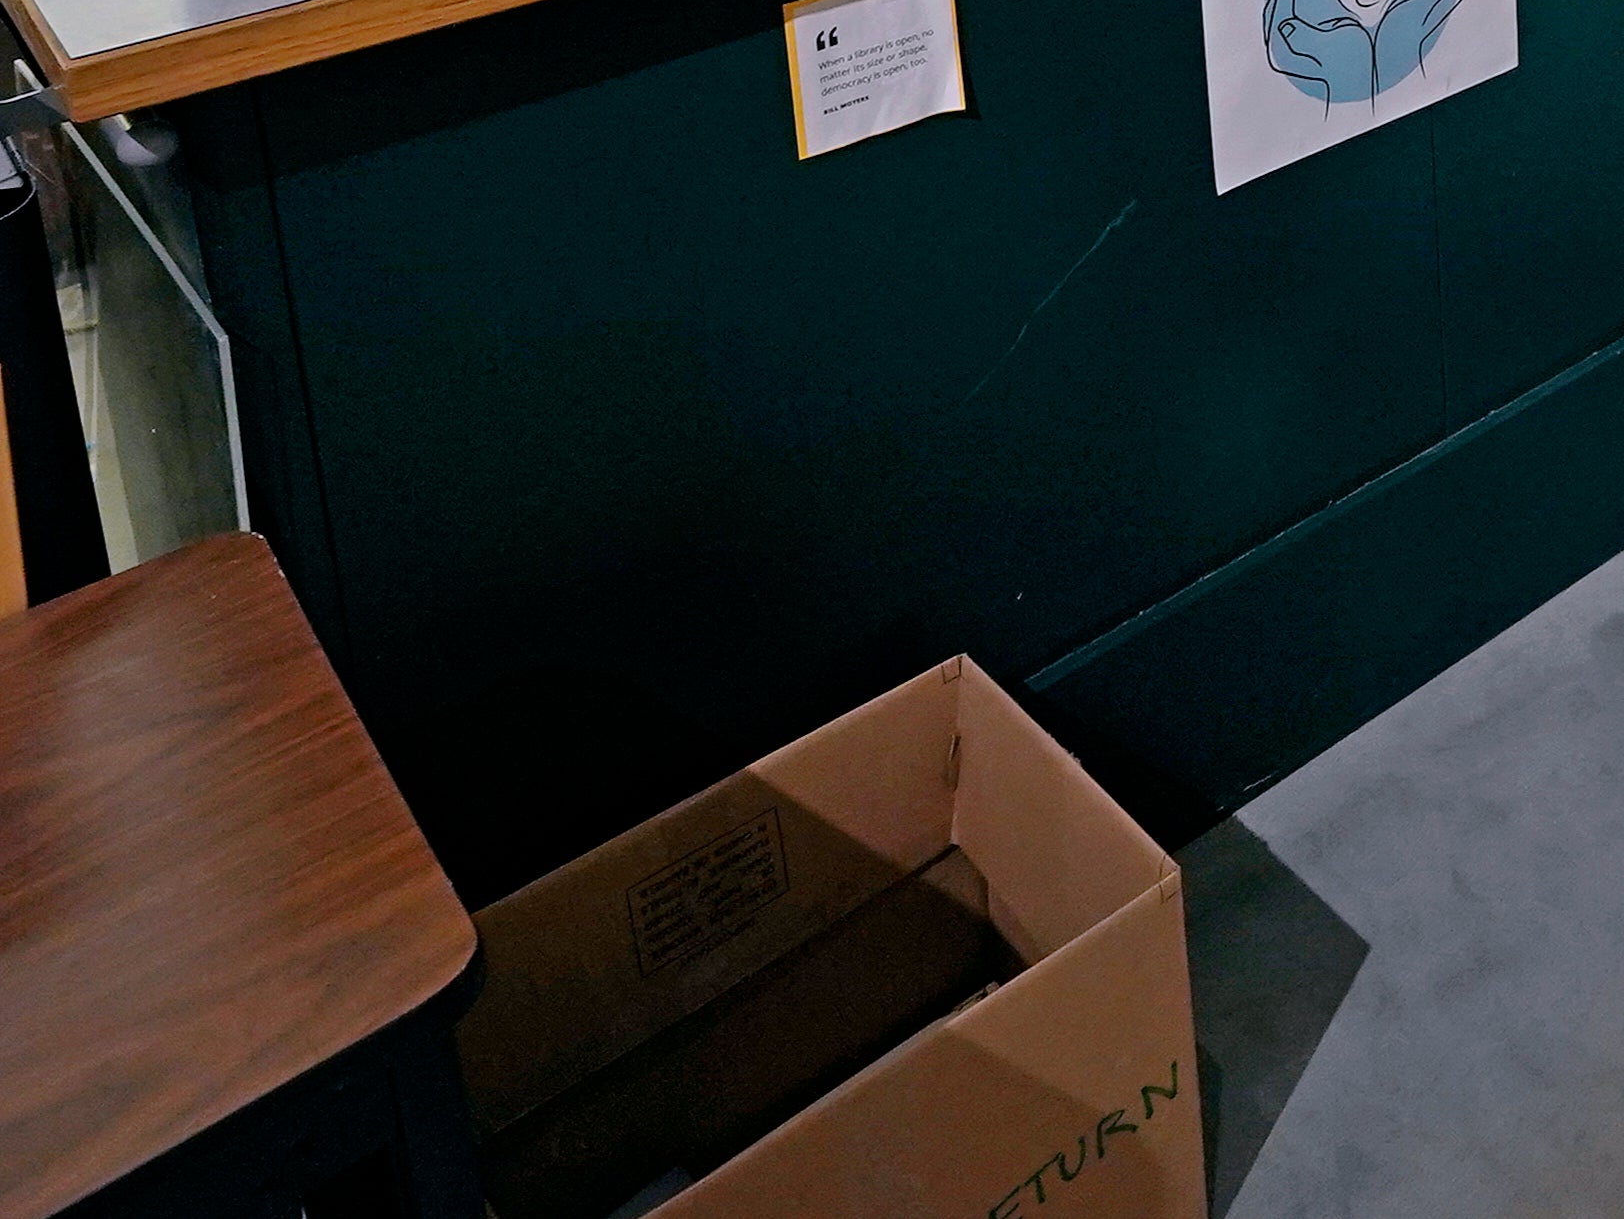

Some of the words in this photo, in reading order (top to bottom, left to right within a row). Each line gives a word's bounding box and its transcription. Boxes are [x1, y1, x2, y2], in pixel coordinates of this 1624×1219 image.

[818, 56, 846, 71] When
[847, 53, 854, 62] a
[854, 43, 884, 59] library
[885, 41, 894, 49] is
[922, 29, 934, 39] no
[819, 66, 851, 84] matter
[853, 62, 866, 74] its
[866, 57, 884, 70] size
[886, 53, 896, 63] or
[820, 74, 873, 97] democracy
[873, 71, 882, 80] is
[823, 105, 839, 115] BILL
[840, 94, 870, 109] MOYERS
